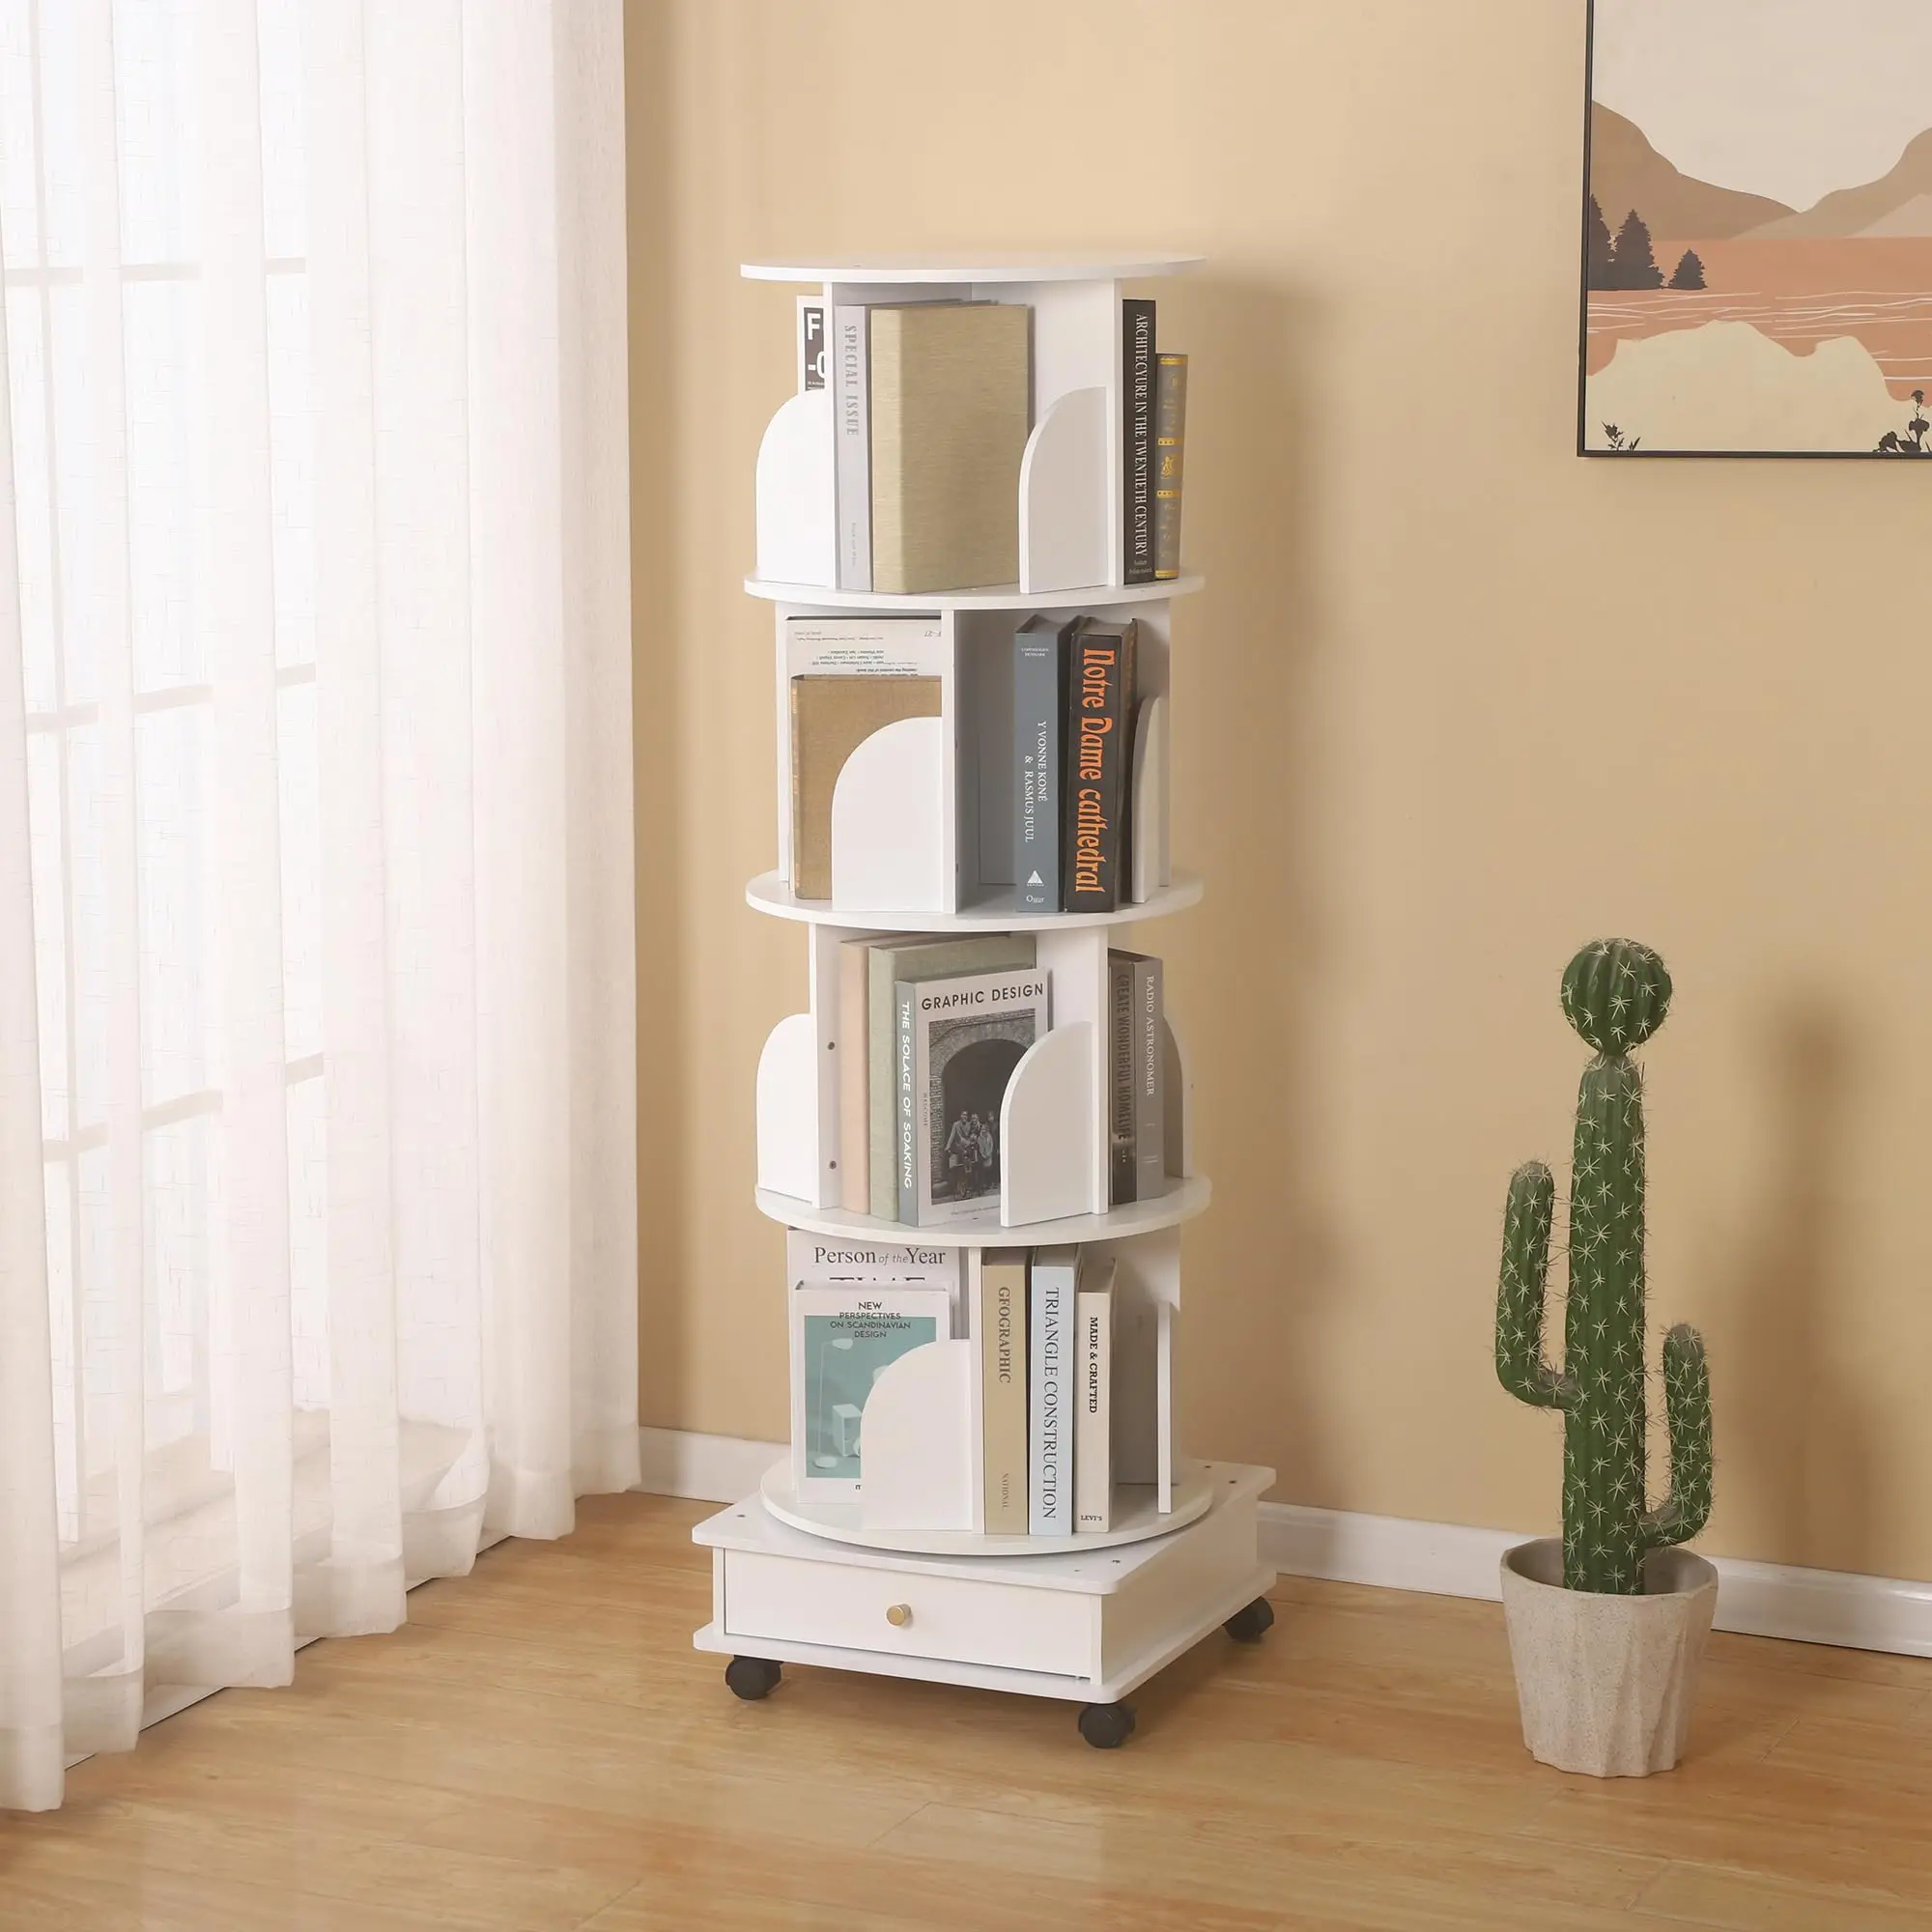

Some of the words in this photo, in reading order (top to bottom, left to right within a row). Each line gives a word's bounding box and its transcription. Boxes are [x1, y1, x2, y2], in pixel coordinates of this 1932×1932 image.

[844, 325, 858, 387] SPECIAL
[1135, 314, 1148, 399] ARCHITECYURE
[845, 395, 859, 436] ISSUE
[1135, 402, 1148, 412] IN
[1135, 415, 1147, 438] THE
[1135, 439, 1147, 503] TWENTIETH
[1135, 505, 1148, 556] CENTURY
[1082, 648, 1115, 708] Notre
[1025, 755, 1034, 764] &
[1079, 717, 1113, 781] Dame
[1025, 771, 1034, 814] RASMUS
[1037, 772, 1049, 802] KONÉ
[1024, 816, 1034, 843] JUUL
[1075, 788, 1108, 893] cathedral
[922, 990, 984, 1010] GRAPHIC
[992, 982, 1043, 1002] DESIGN
[1117, 974, 1130, 1013] CREATE
[1146, 976, 1154, 1013] RADIO
[902, 1035, 911, 1092] SOLACE
[1146, 1016, 1154, 1095] ASTRONOMER
[903, 1096, 911, 1118] OF
[903, 1122, 912, 1189] SOAKING
[814, 1247, 876, 1264] Person
[878, 1254, 889, 1265] of
[893, 1254, 908, 1263] the
[905, 1247, 946, 1264] Year
[1044, 1287, 1060, 1377] TRIANGLE
[1090, 1317, 1098, 1350] MADE
[1089, 1351, 1098, 1360] &
[1089, 1362, 1097, 1413] CRAFTED
[1042, 1381, 1058, 1519] CONSTRUCTION
